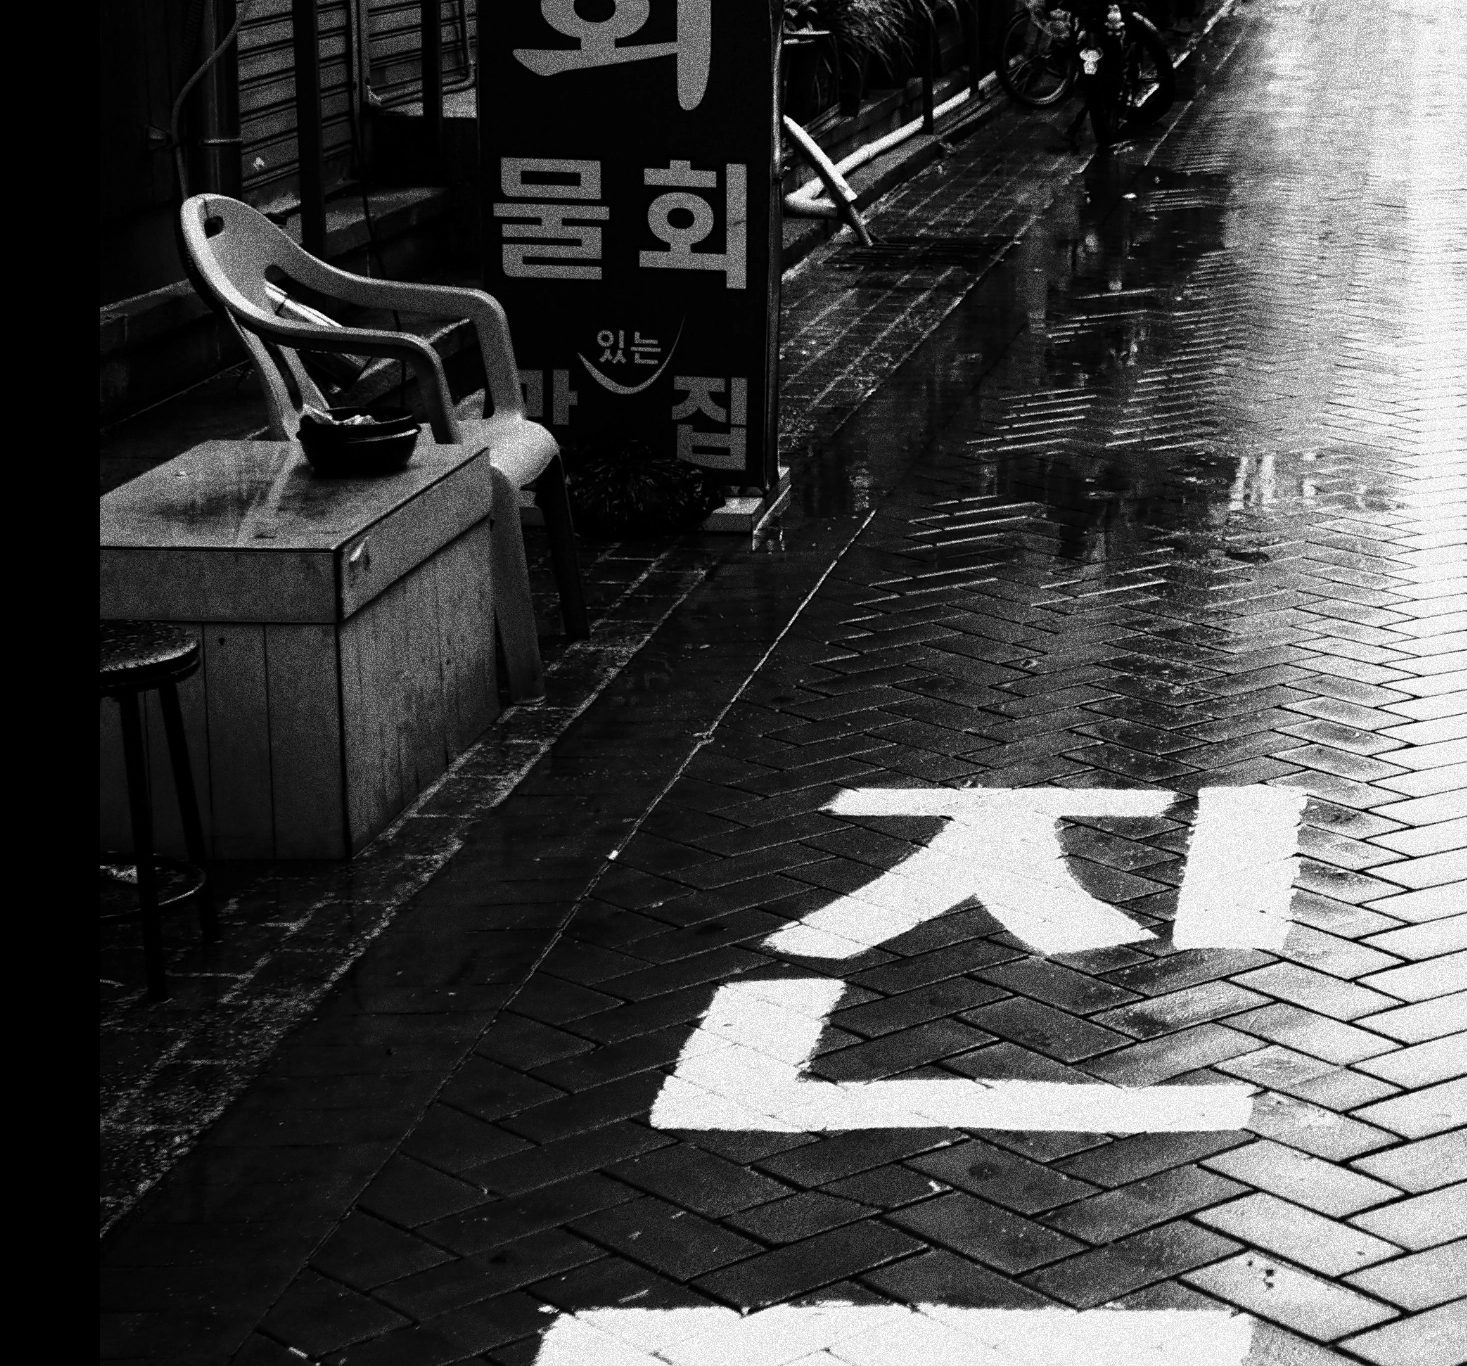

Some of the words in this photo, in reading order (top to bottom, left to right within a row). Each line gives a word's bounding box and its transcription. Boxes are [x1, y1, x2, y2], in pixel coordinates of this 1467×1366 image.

[493, 157, 747, 290] 물회
[596, 329, 662, 366] 있는
[671, 374, 748, 471] 집
